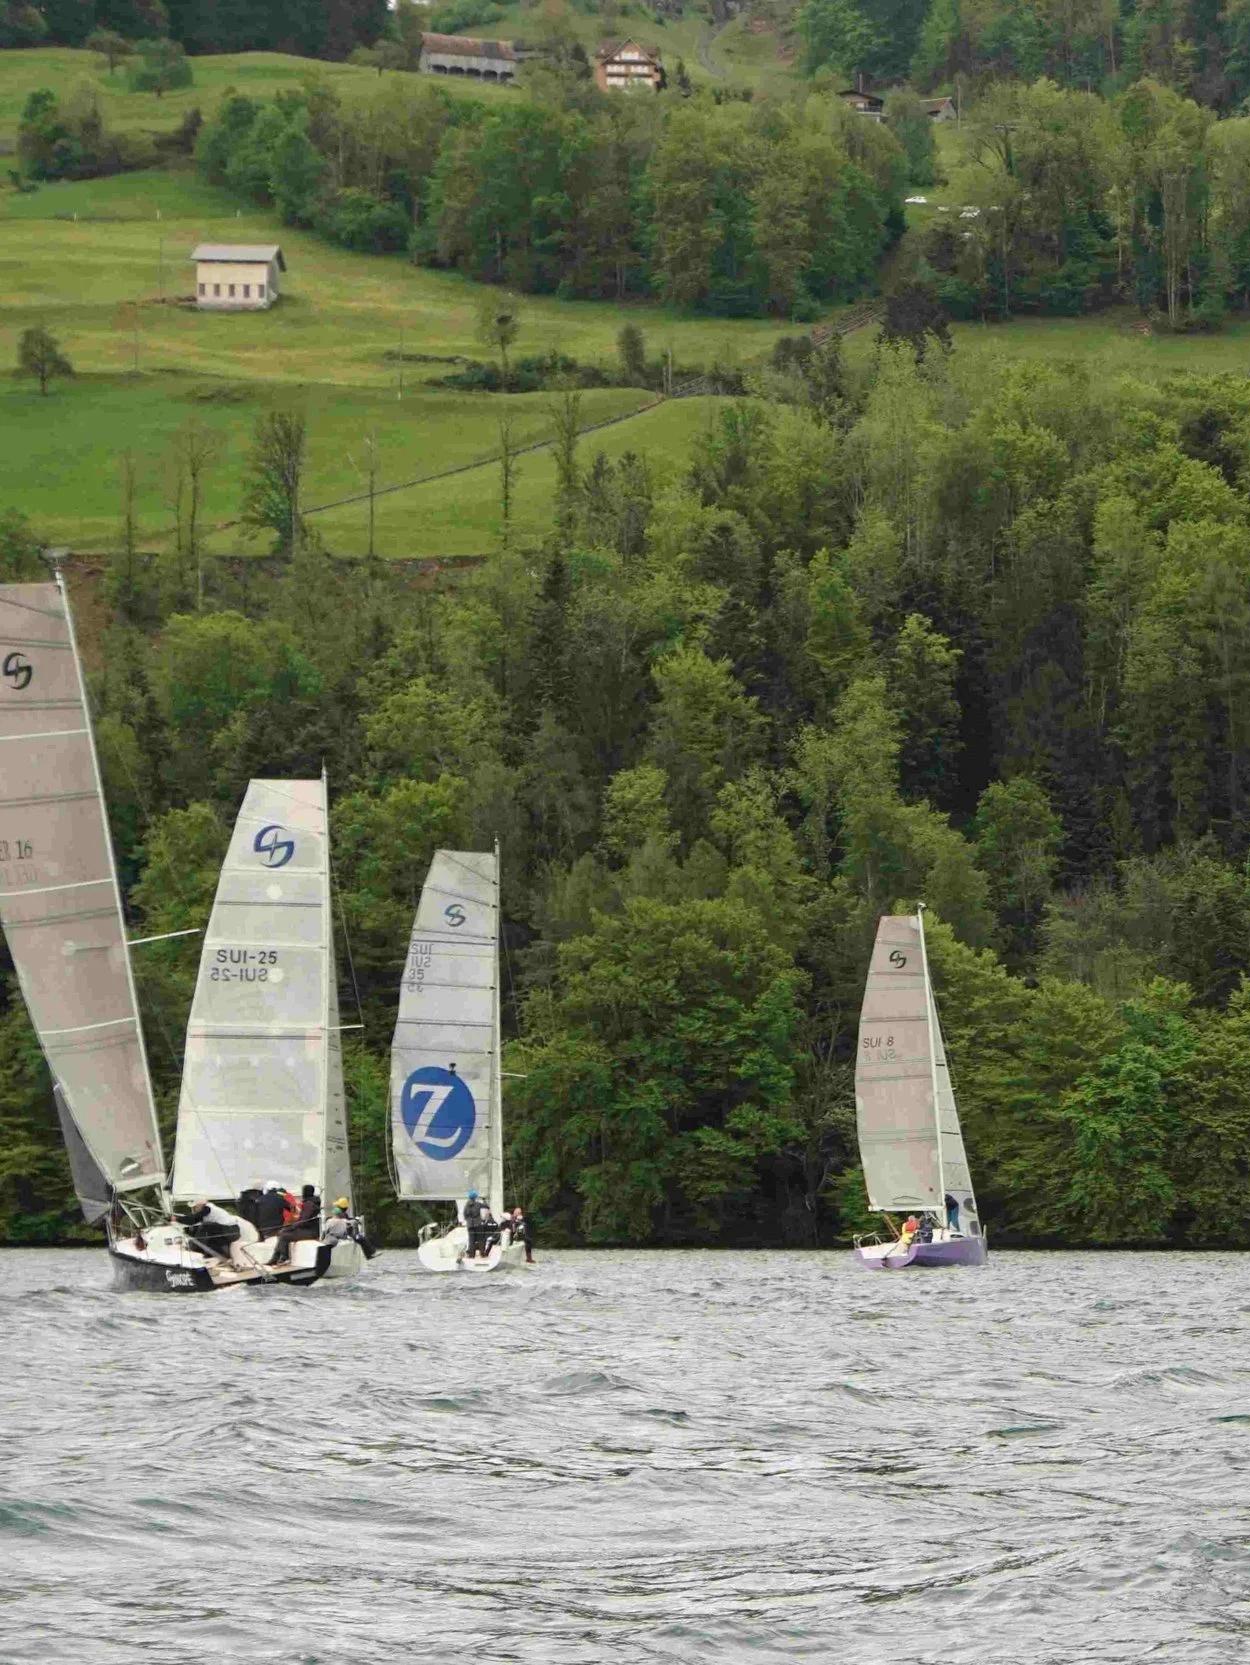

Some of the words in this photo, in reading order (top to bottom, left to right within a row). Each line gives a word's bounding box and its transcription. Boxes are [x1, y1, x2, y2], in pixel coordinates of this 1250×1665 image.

[15, 839, 33, 859] 16
[216, 949, 277, 964] SUI-25
[862, 1036, 881, 1048] SUI
[886, 1036, 895, 1047] 8
[410, 1084, 461, 1148] Z
